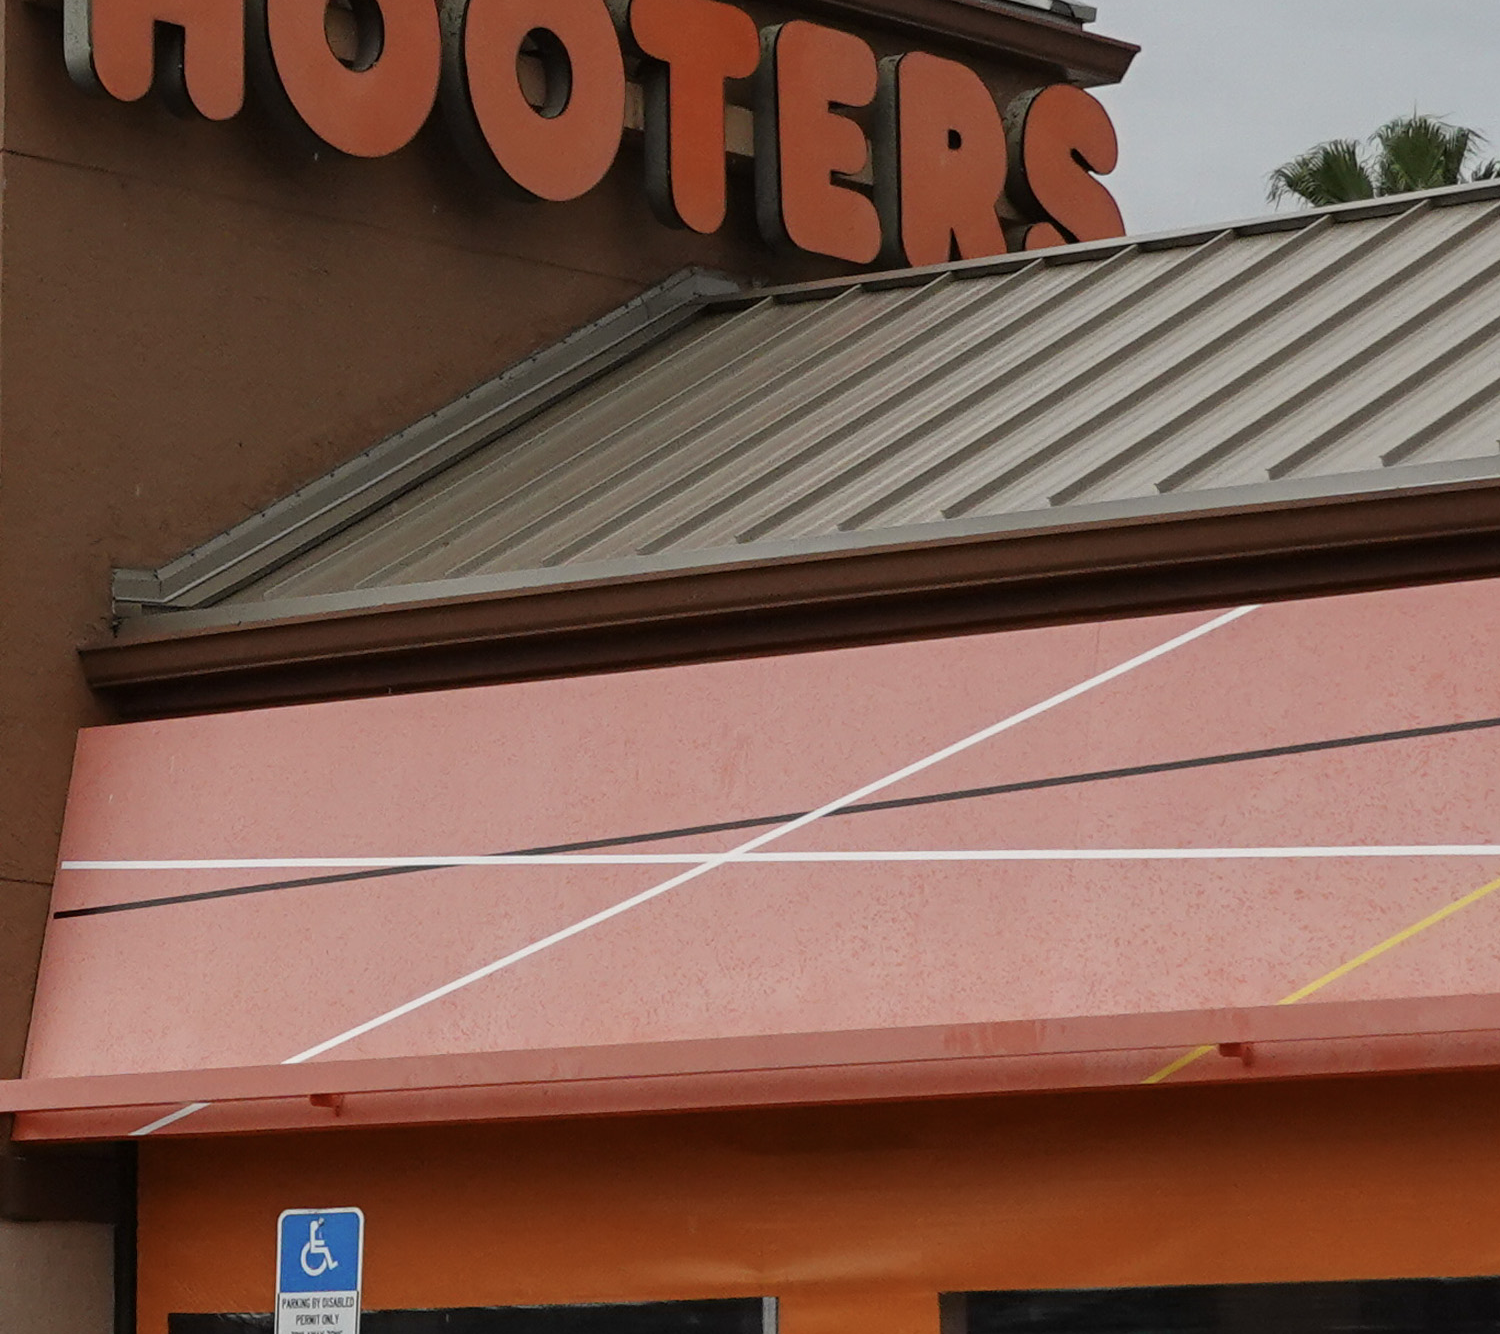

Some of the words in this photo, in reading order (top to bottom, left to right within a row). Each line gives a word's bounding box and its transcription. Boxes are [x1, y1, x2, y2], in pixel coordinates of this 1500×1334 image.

[282, 1298, 311, 1309] PARKING
[312, 1297, 320, 1309] BY
[322, 1296, 355, 1308] DISABLED
[295, 1314, 320, 1325] PERMIT
[322, 1314, 340, 1325] ONLY
